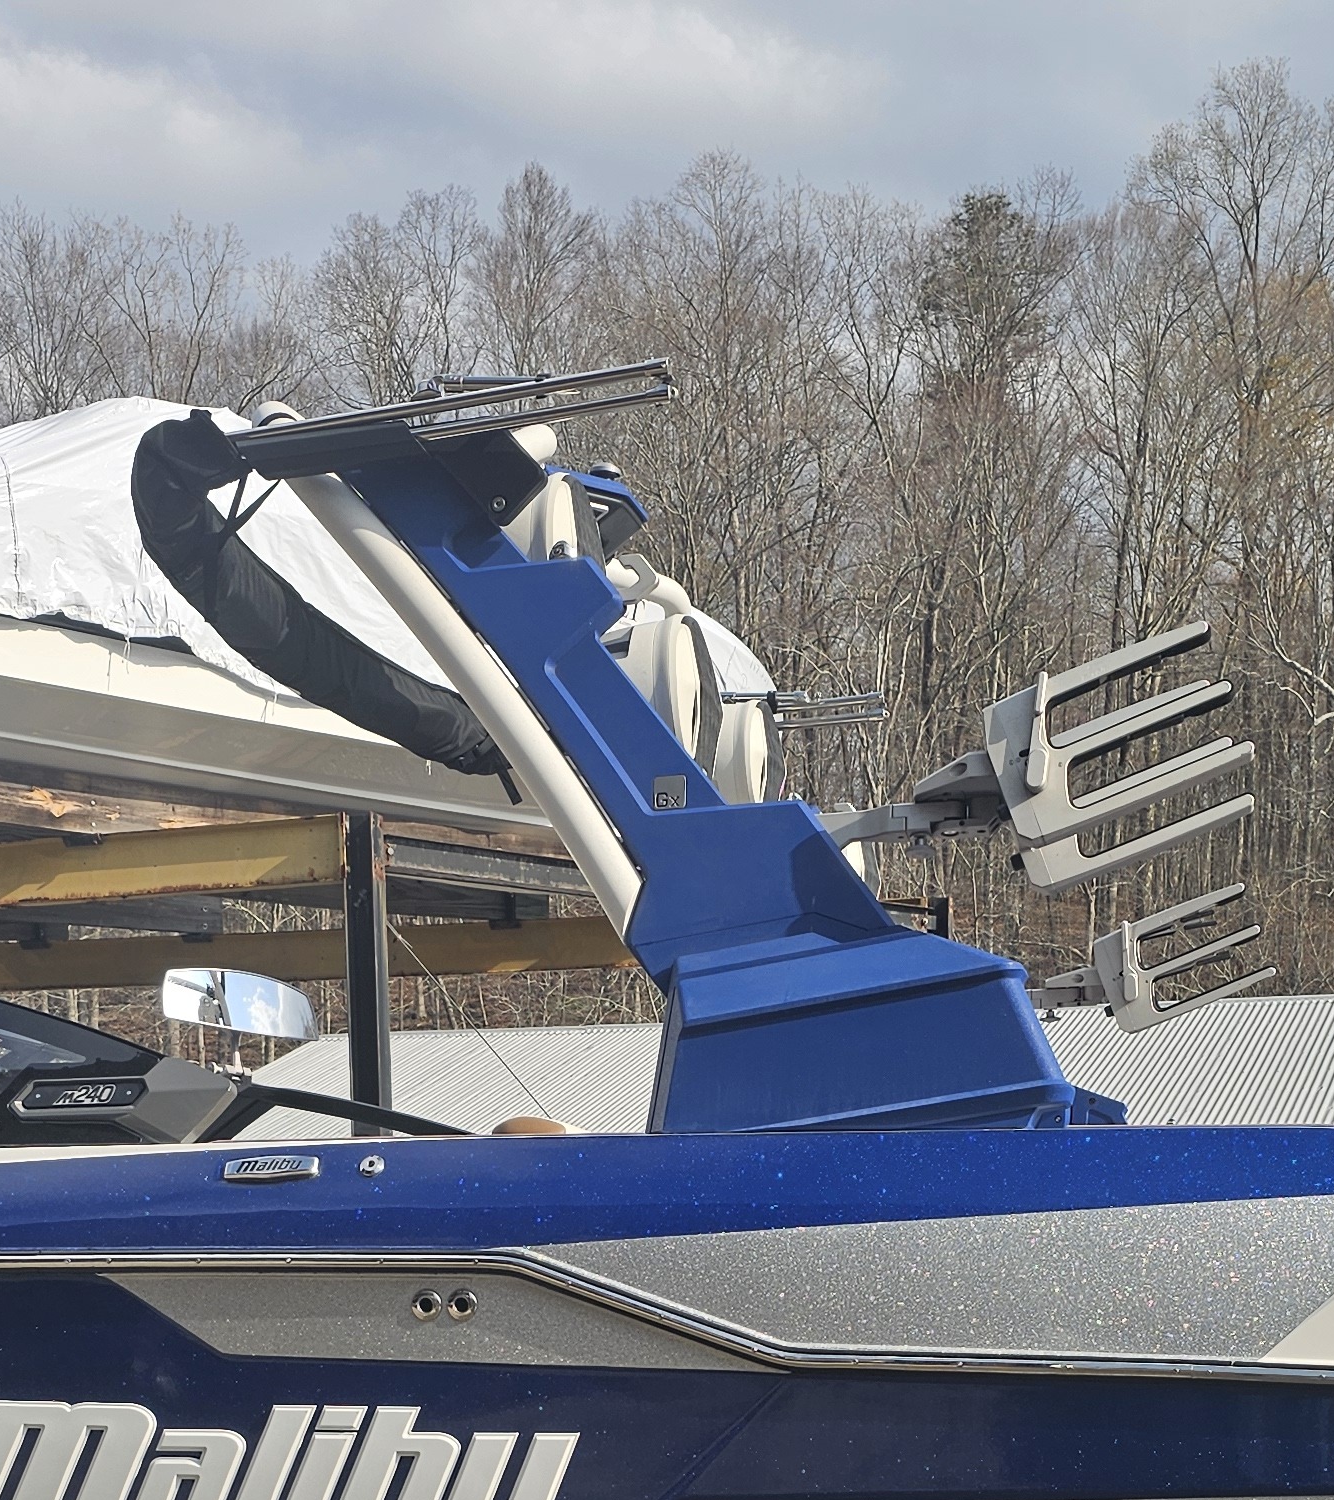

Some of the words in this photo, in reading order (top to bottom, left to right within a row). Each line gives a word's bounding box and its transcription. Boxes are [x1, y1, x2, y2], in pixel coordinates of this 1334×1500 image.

[656, 792, 680, 808] Gx
[52, 1083, 117, 1106] M240
[235, 1158, 303, 1174] Malibu
